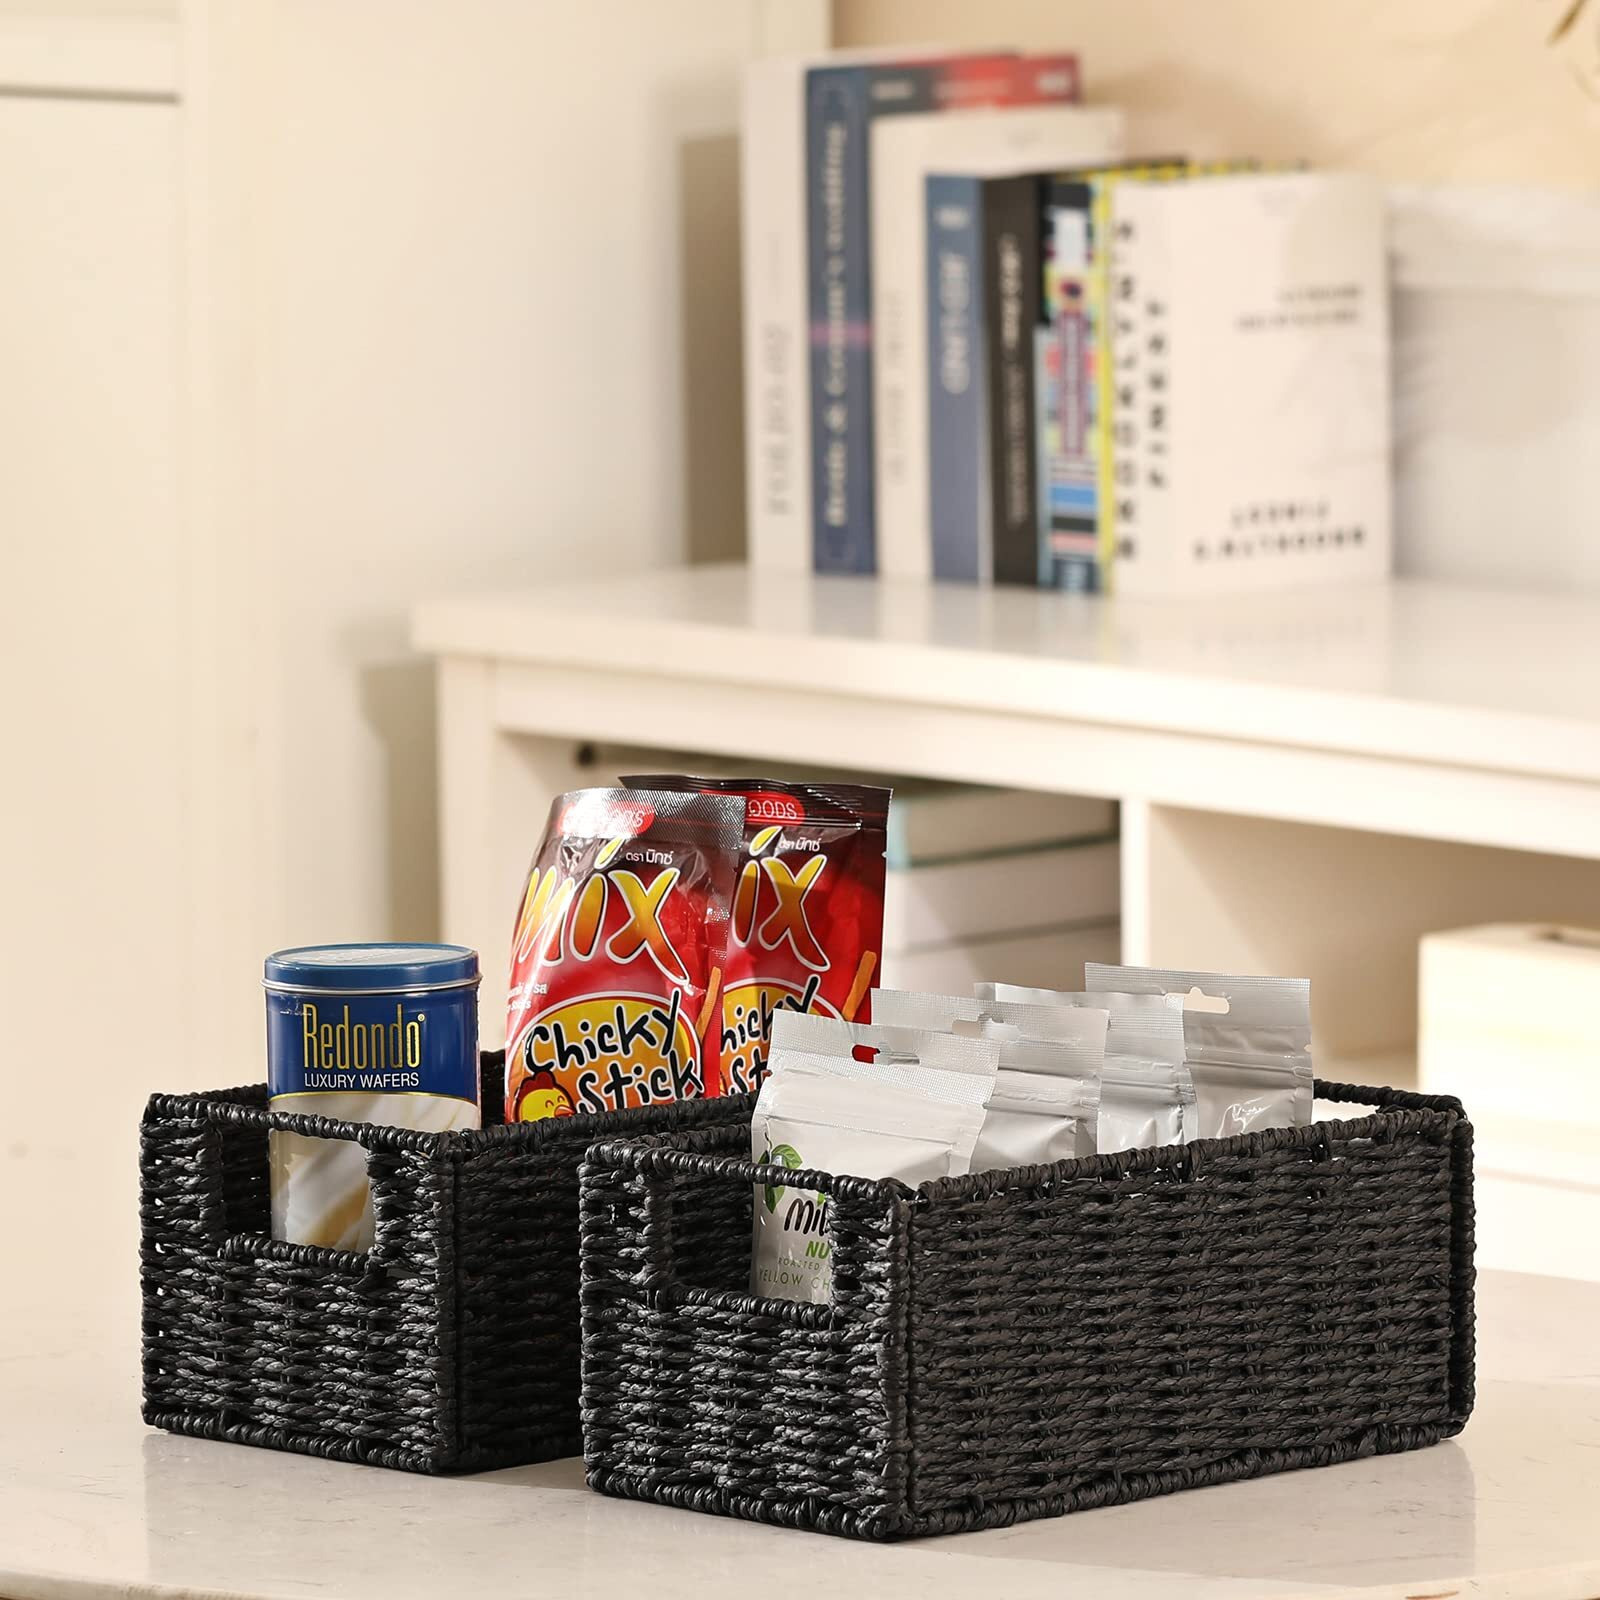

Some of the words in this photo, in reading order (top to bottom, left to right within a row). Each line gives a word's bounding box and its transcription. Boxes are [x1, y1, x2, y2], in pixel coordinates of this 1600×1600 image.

[646, 848, 674, 865] มิกซ์
[303, 1003, 420, 1069] Redondo
[304, 1073, 357, 1089] LUXURY
[359, 1072, 420, 1088] WAFERS
[778, 1257, 820, 1270] ROASTED
[759, 1268, 804, 1286] YELLOW
